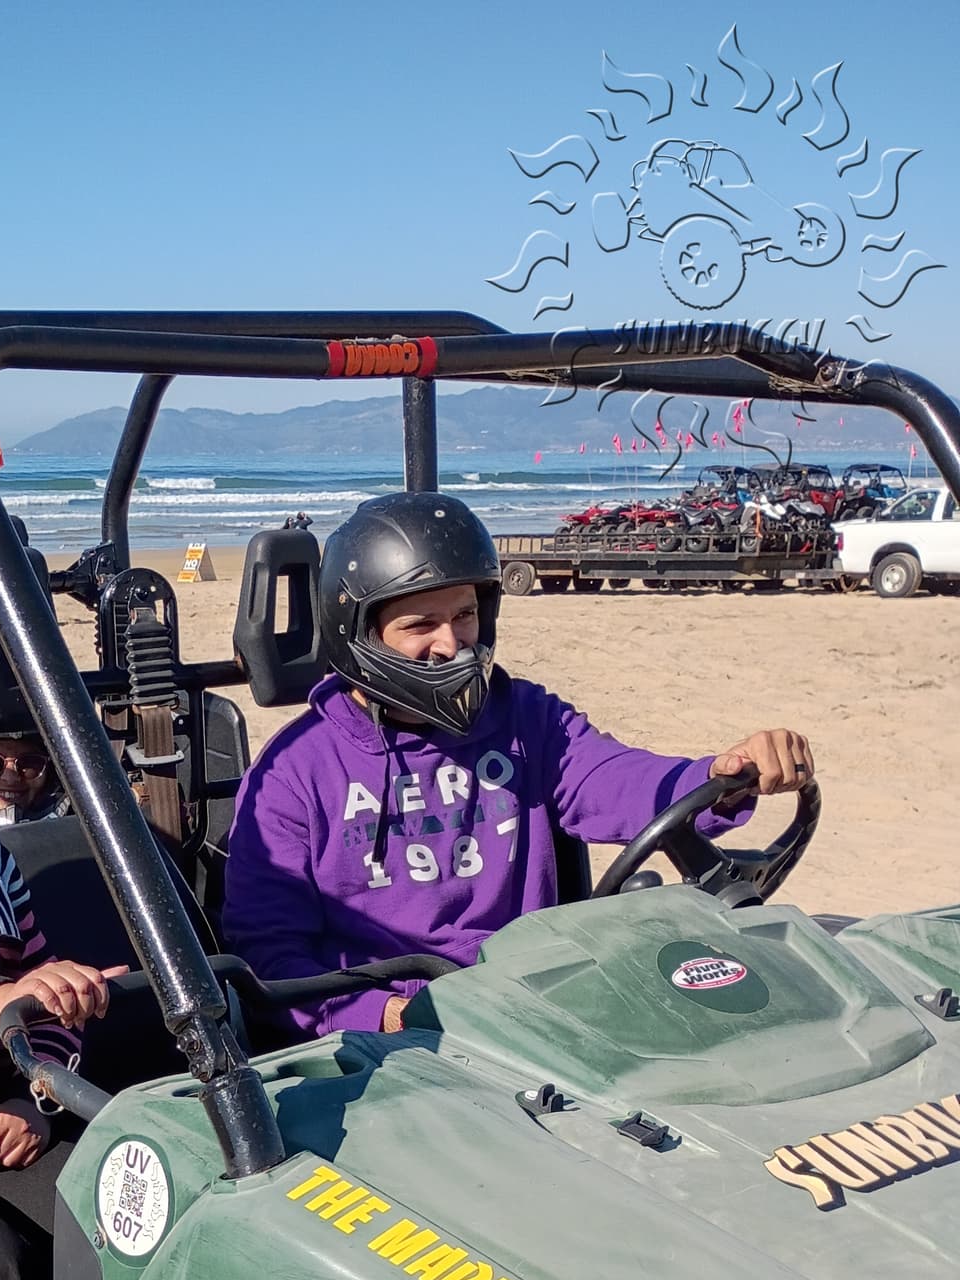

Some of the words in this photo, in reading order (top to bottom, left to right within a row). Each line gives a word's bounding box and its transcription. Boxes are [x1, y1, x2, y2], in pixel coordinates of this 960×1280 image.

[343, 749, 515, 821] AERO
[363, 816, 519, 888] 1987
[682, 960, 729, 977] Pivot
[682, 967, 740, 985] Works
[125, 1143, 151, 1174] UV
[763, 1093, 960, 1211] SUNBU
[286, 1165, 391, 1234] THE
[113, 1211, 144, 1242] 607
